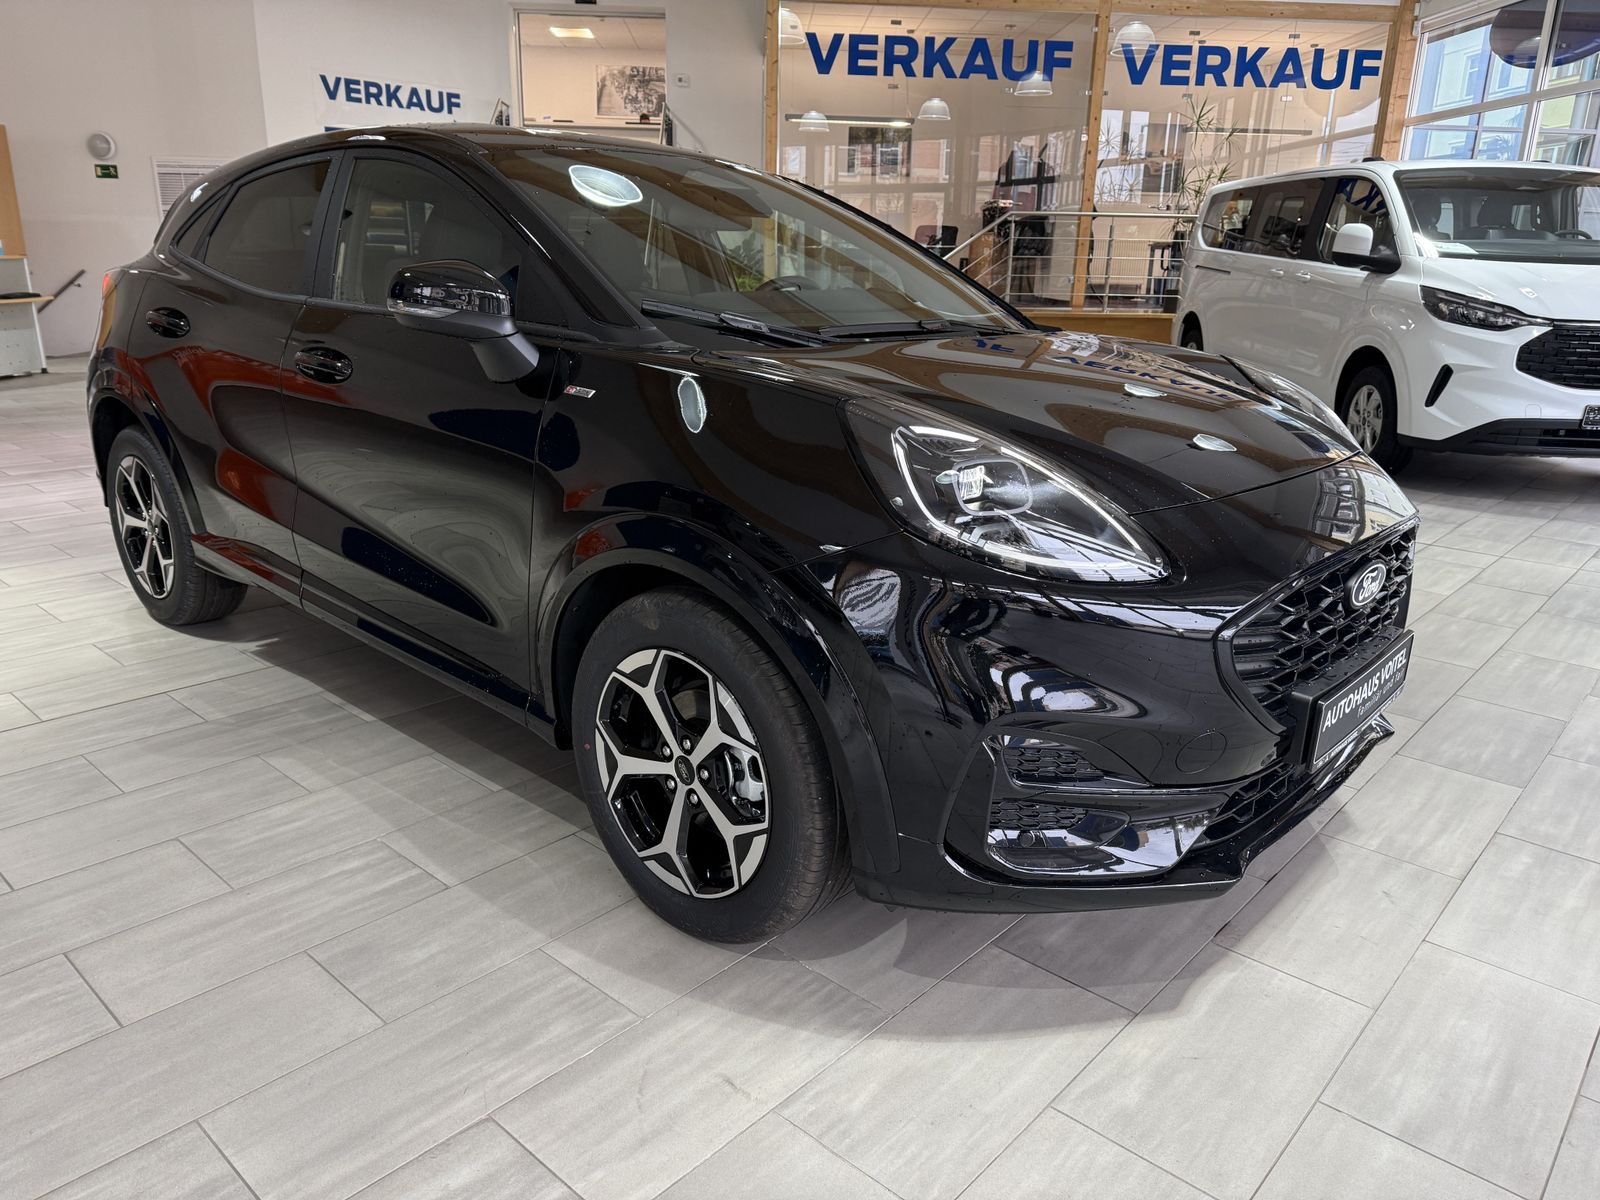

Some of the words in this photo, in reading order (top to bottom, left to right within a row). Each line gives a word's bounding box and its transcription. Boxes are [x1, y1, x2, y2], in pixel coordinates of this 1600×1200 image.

[805, 32, 1074, 82] VERKAUF
[1121, 43, 1383, 90] VERKAUF
[319, 74, 461, 115] VERKAUF
[1322, 671, 1380, 733] AUTOHAUS
